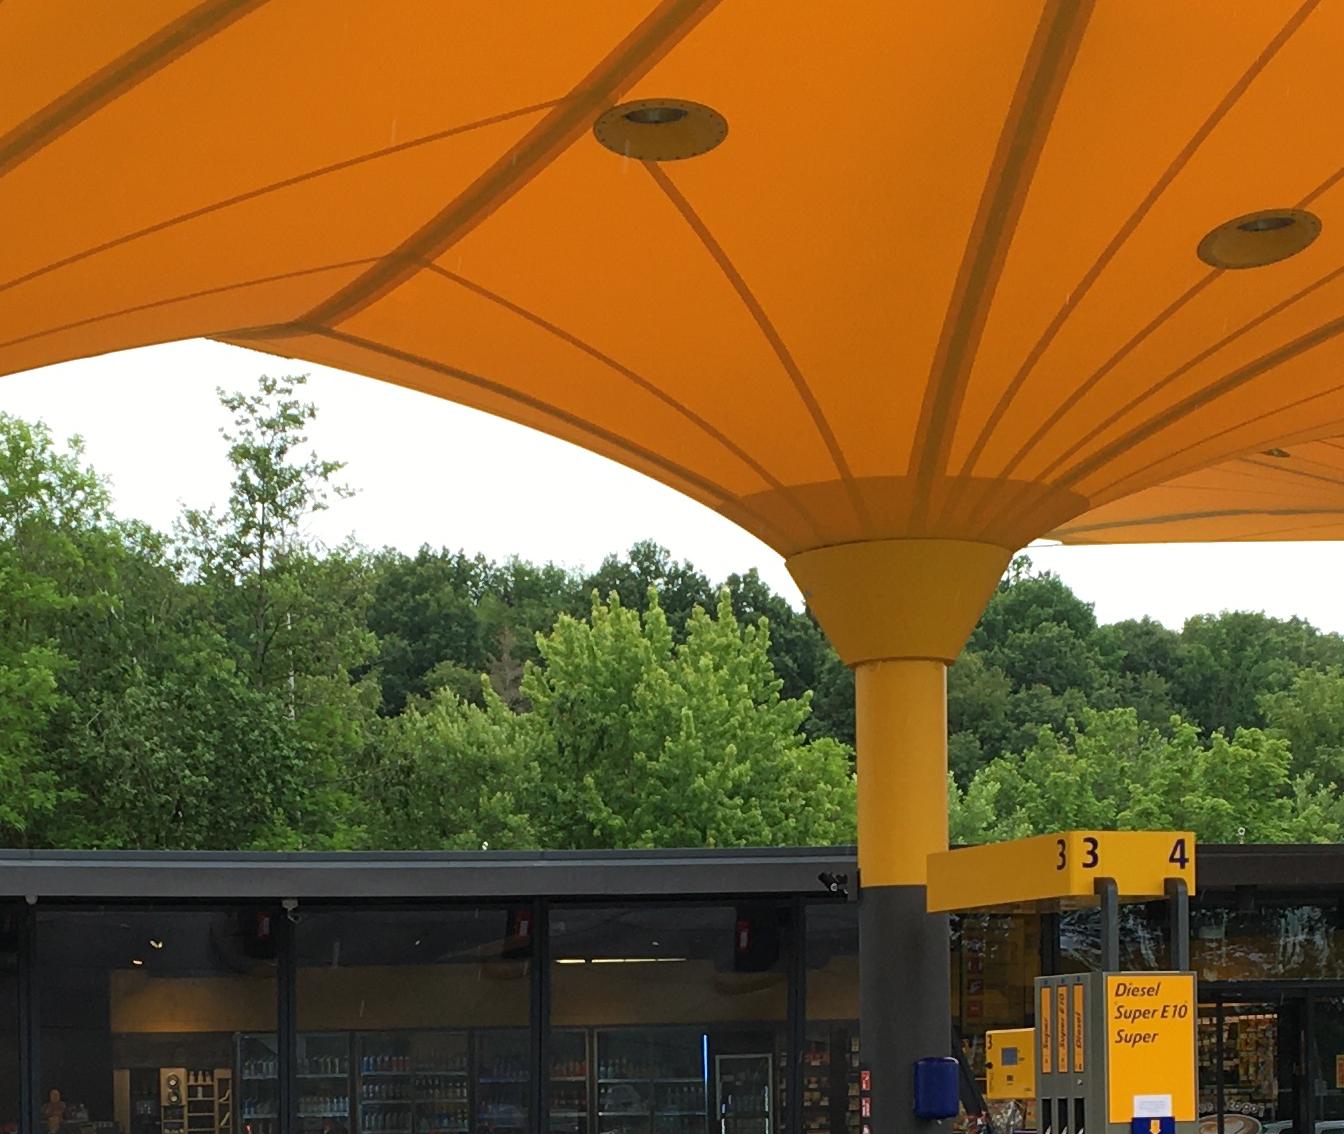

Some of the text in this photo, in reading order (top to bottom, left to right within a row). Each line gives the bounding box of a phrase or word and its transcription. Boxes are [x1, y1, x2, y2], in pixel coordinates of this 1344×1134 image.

[1056, 839, 1066, 870] 3
[1081, 837, 1099, 868] 3
[1168, 838, 1189, 870] 4
[1114, 981, 1162, 998] Diesel
[1114, 1004, 1189, 1025] Super E10
[1114, 1028, 1159, 1049] Super
